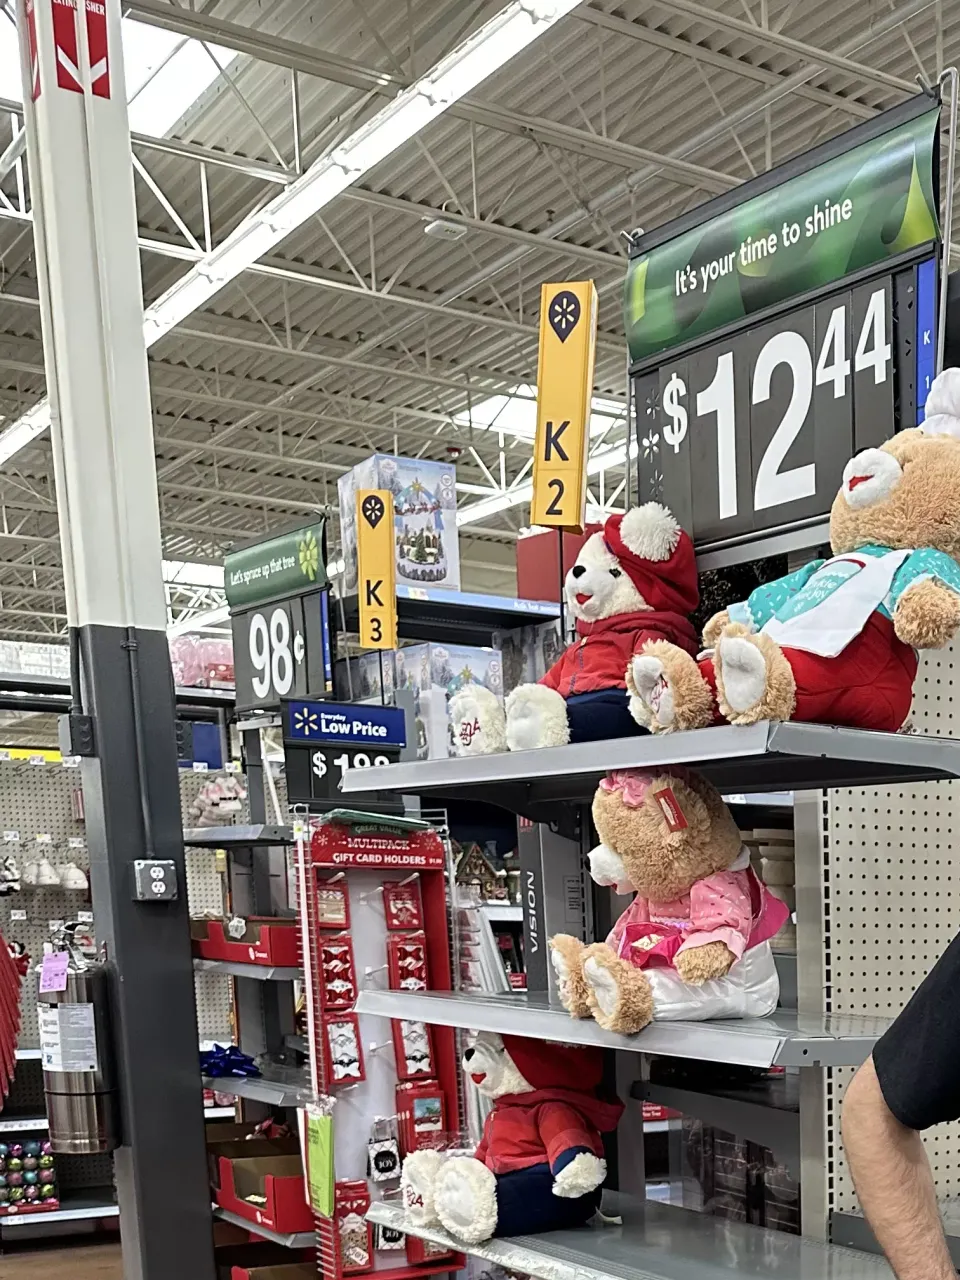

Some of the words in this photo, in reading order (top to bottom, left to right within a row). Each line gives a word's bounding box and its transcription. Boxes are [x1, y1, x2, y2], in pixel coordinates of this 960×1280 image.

[675, 265, 698, 297] It's
[701, 250, 736, 293] your
[739, 232, 777, 266] time
[782, 222, 801, 247] to
[805, 199, 853, 237] shine
[923, 330, 931, 346] K
[925, 377, 930, 390] 1
[544, 421, 570, 461] K
[545, 479, 565, 516] 2
[230, 570, 244, 586] Let's
[243, 567, 262, 585] spruce
[262, 565, 270, 579] up
[270, 558, 282, 573] that
[282, 556, 296, 570] tree
[366, 579, 385, 607] K
[370, 618, 383, 642] 3
[320, 713, 347, 722] Everyday
[321, 720, 351, 735] Low
[353, 721, 388, 737] Price
[347, 838, 410, 850] MULTIPACK
[333, 854, 353, 864] GIFT
[356, 854, 382, 864] CARD
[384, 856, 426, 865] HOLDERS
[526, 871, 539, 954] VISION
[378, 1159, 394, 1169] JOY
